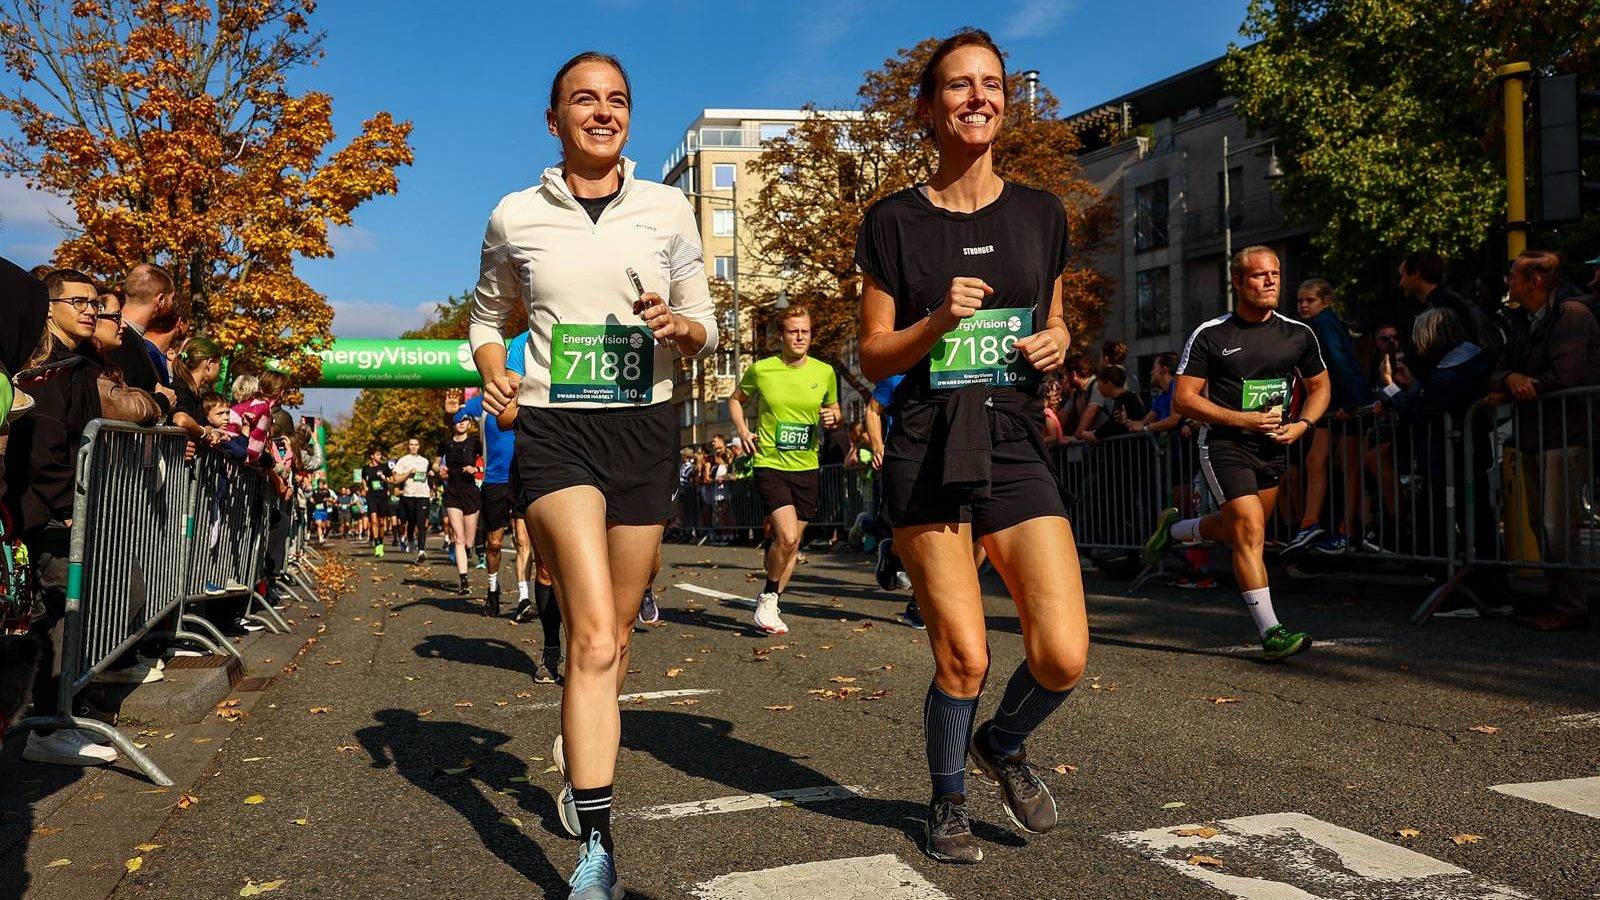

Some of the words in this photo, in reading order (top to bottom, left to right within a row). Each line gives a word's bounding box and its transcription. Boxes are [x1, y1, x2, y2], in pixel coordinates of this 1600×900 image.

[963, 245, 994, 255] STRONGER
[959, 319, 1007, 331] rgyVision
[562, 333, 629, 346] EnergyVision
[944, 335, 1020, 366] 7189
[563, 350, 641, 381] 7188
[394, 373, 422, 381] simple
[1003, 372, 1017, 382] 10
[624, 388, 638, 399] 10
[780, 431, 809, 444] 8618
